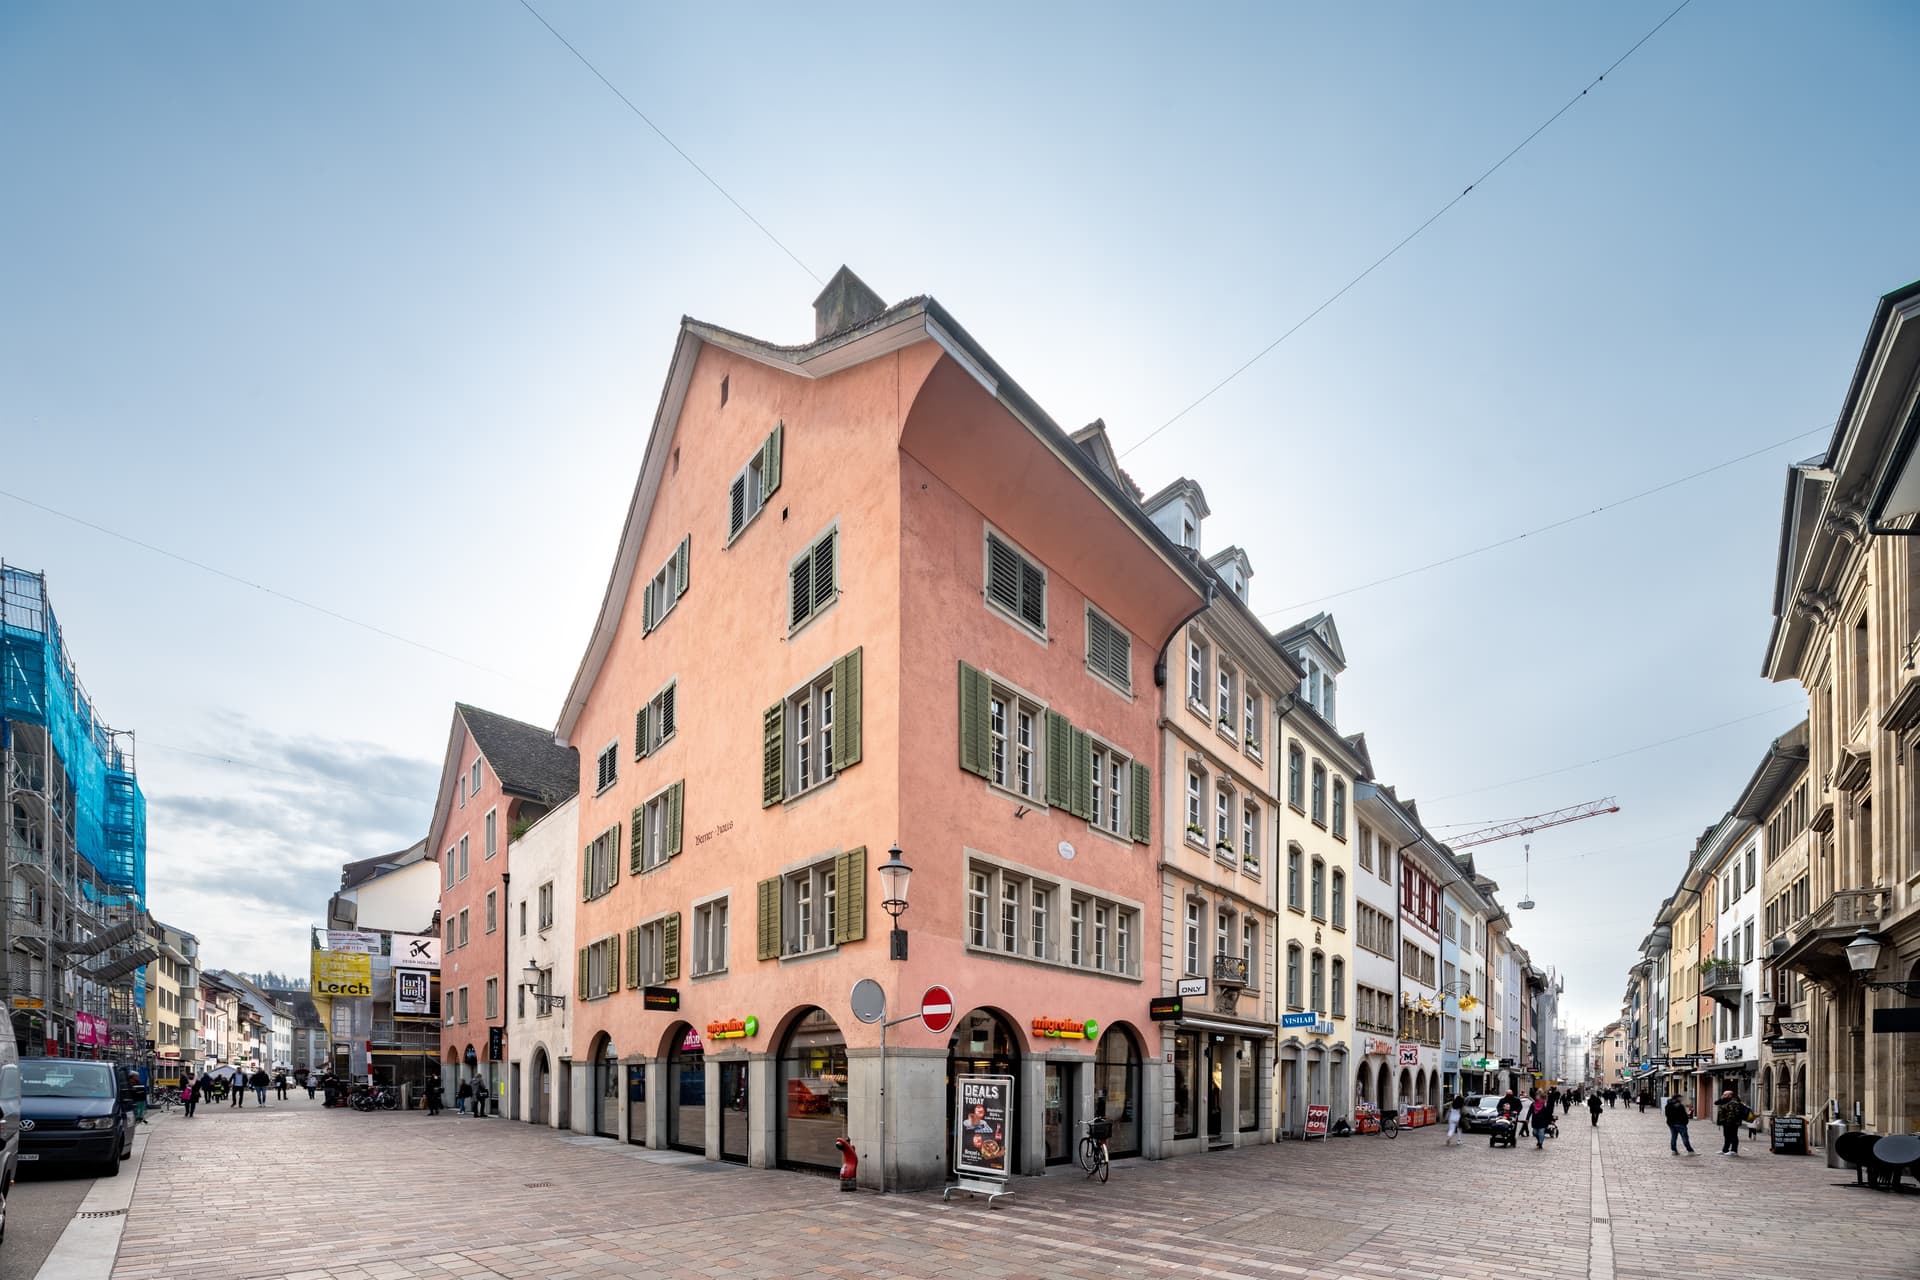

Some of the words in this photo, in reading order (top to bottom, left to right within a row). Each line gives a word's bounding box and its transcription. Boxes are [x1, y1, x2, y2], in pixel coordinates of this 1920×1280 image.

[318, 981, 370, 994] Lerch
[707, 1018, 745, 1034] migrolino
[1032, 1016, 1084, 1033] migrolino
[1284, 1016, 1314, 1025] VISILAB
[965, 1085, 999, 1098] DEALS
[965, 1097, 984, 1105] TODAY
[1309, 1109, 1329, 1117] 70%
